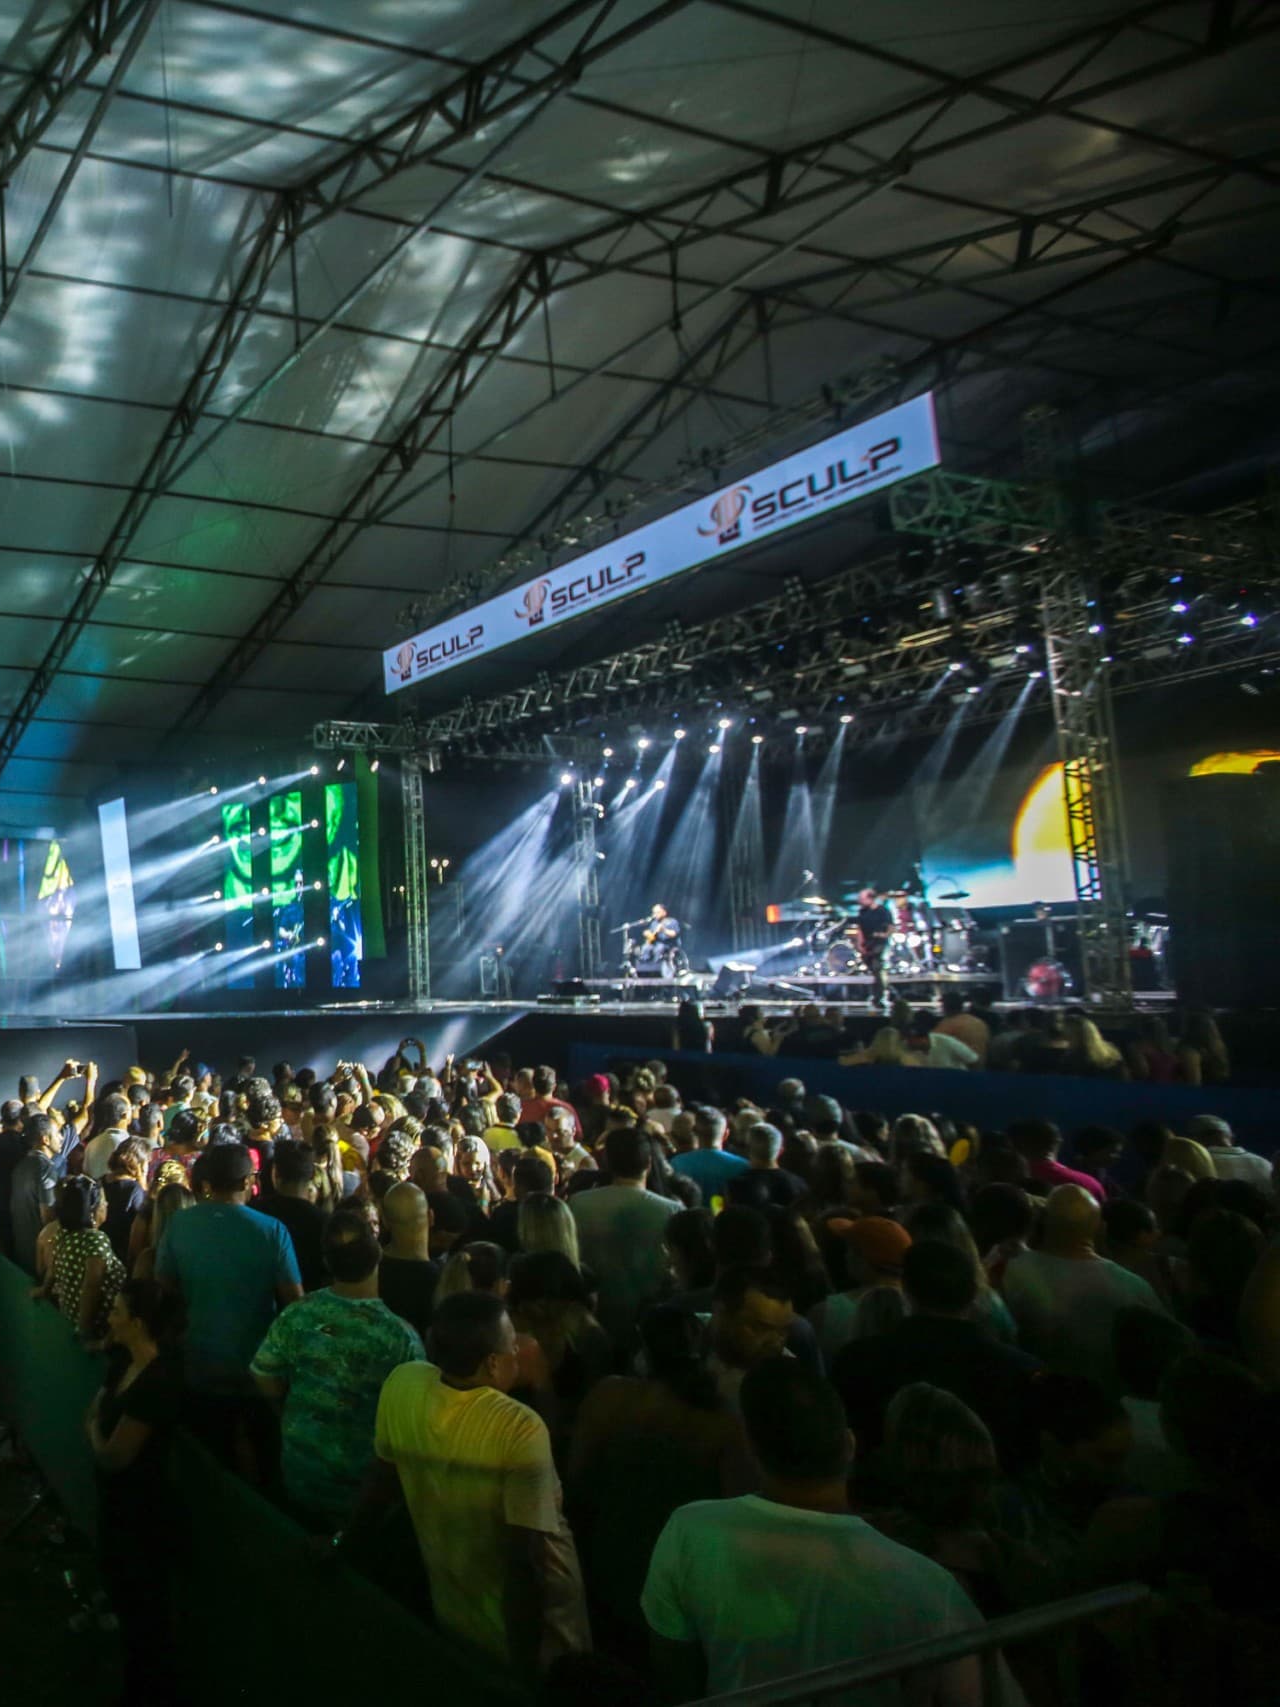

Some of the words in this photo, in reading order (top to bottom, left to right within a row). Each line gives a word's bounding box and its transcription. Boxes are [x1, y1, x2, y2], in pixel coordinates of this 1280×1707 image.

[751, 437, 901, 522] SCULP
[551, 551, 646, 610] SCULP
[416, 624, 484, 668] SCULP
